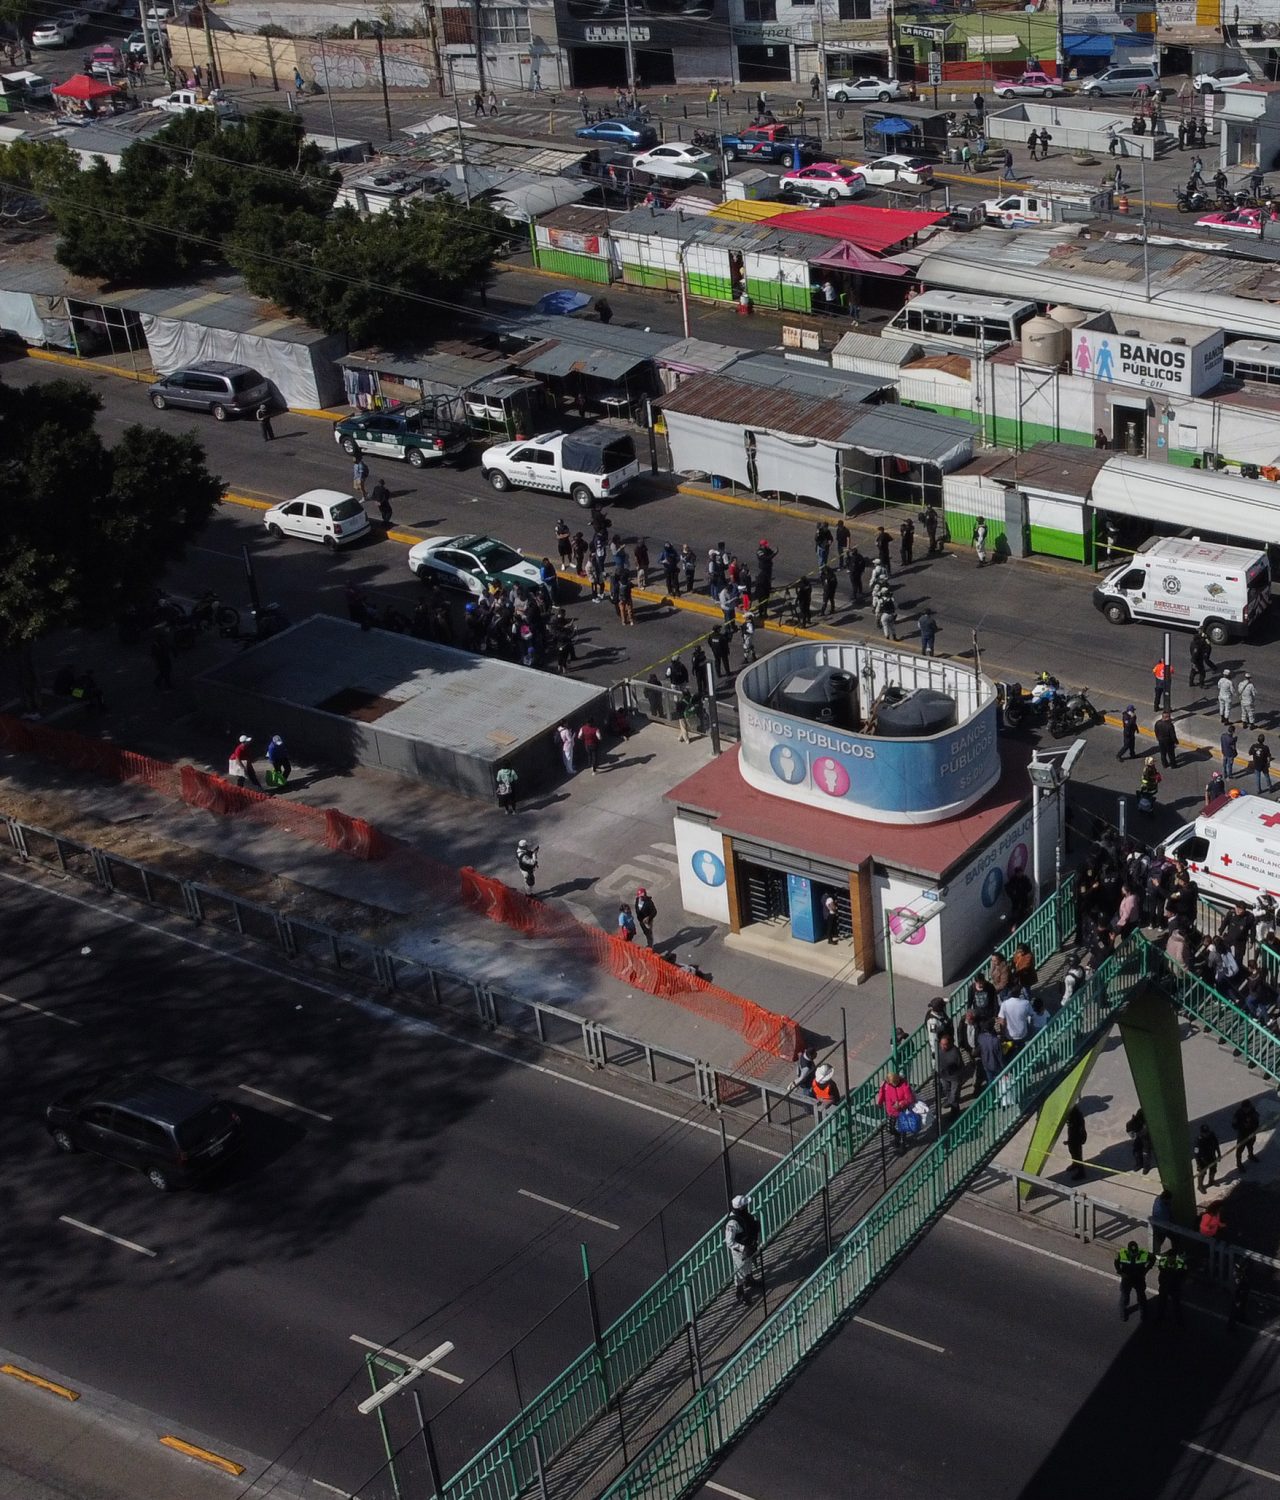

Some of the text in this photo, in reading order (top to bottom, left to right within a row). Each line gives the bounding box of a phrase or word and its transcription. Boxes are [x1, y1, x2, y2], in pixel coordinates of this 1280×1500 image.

[901, 27, 912, 35] LA
[1120, 342, 1185, 369] BAÑOS
[1122, 361, 1182, 382] PÚBLICOS
[1153, 600, 1190, 612] AMBULANCIA
[748, 713, 875, 759] BAÑOS PÚBLICOS
[1236, 860, 1250, 870] CRUZ
[1251, 866, 1265, 875] ROJA
